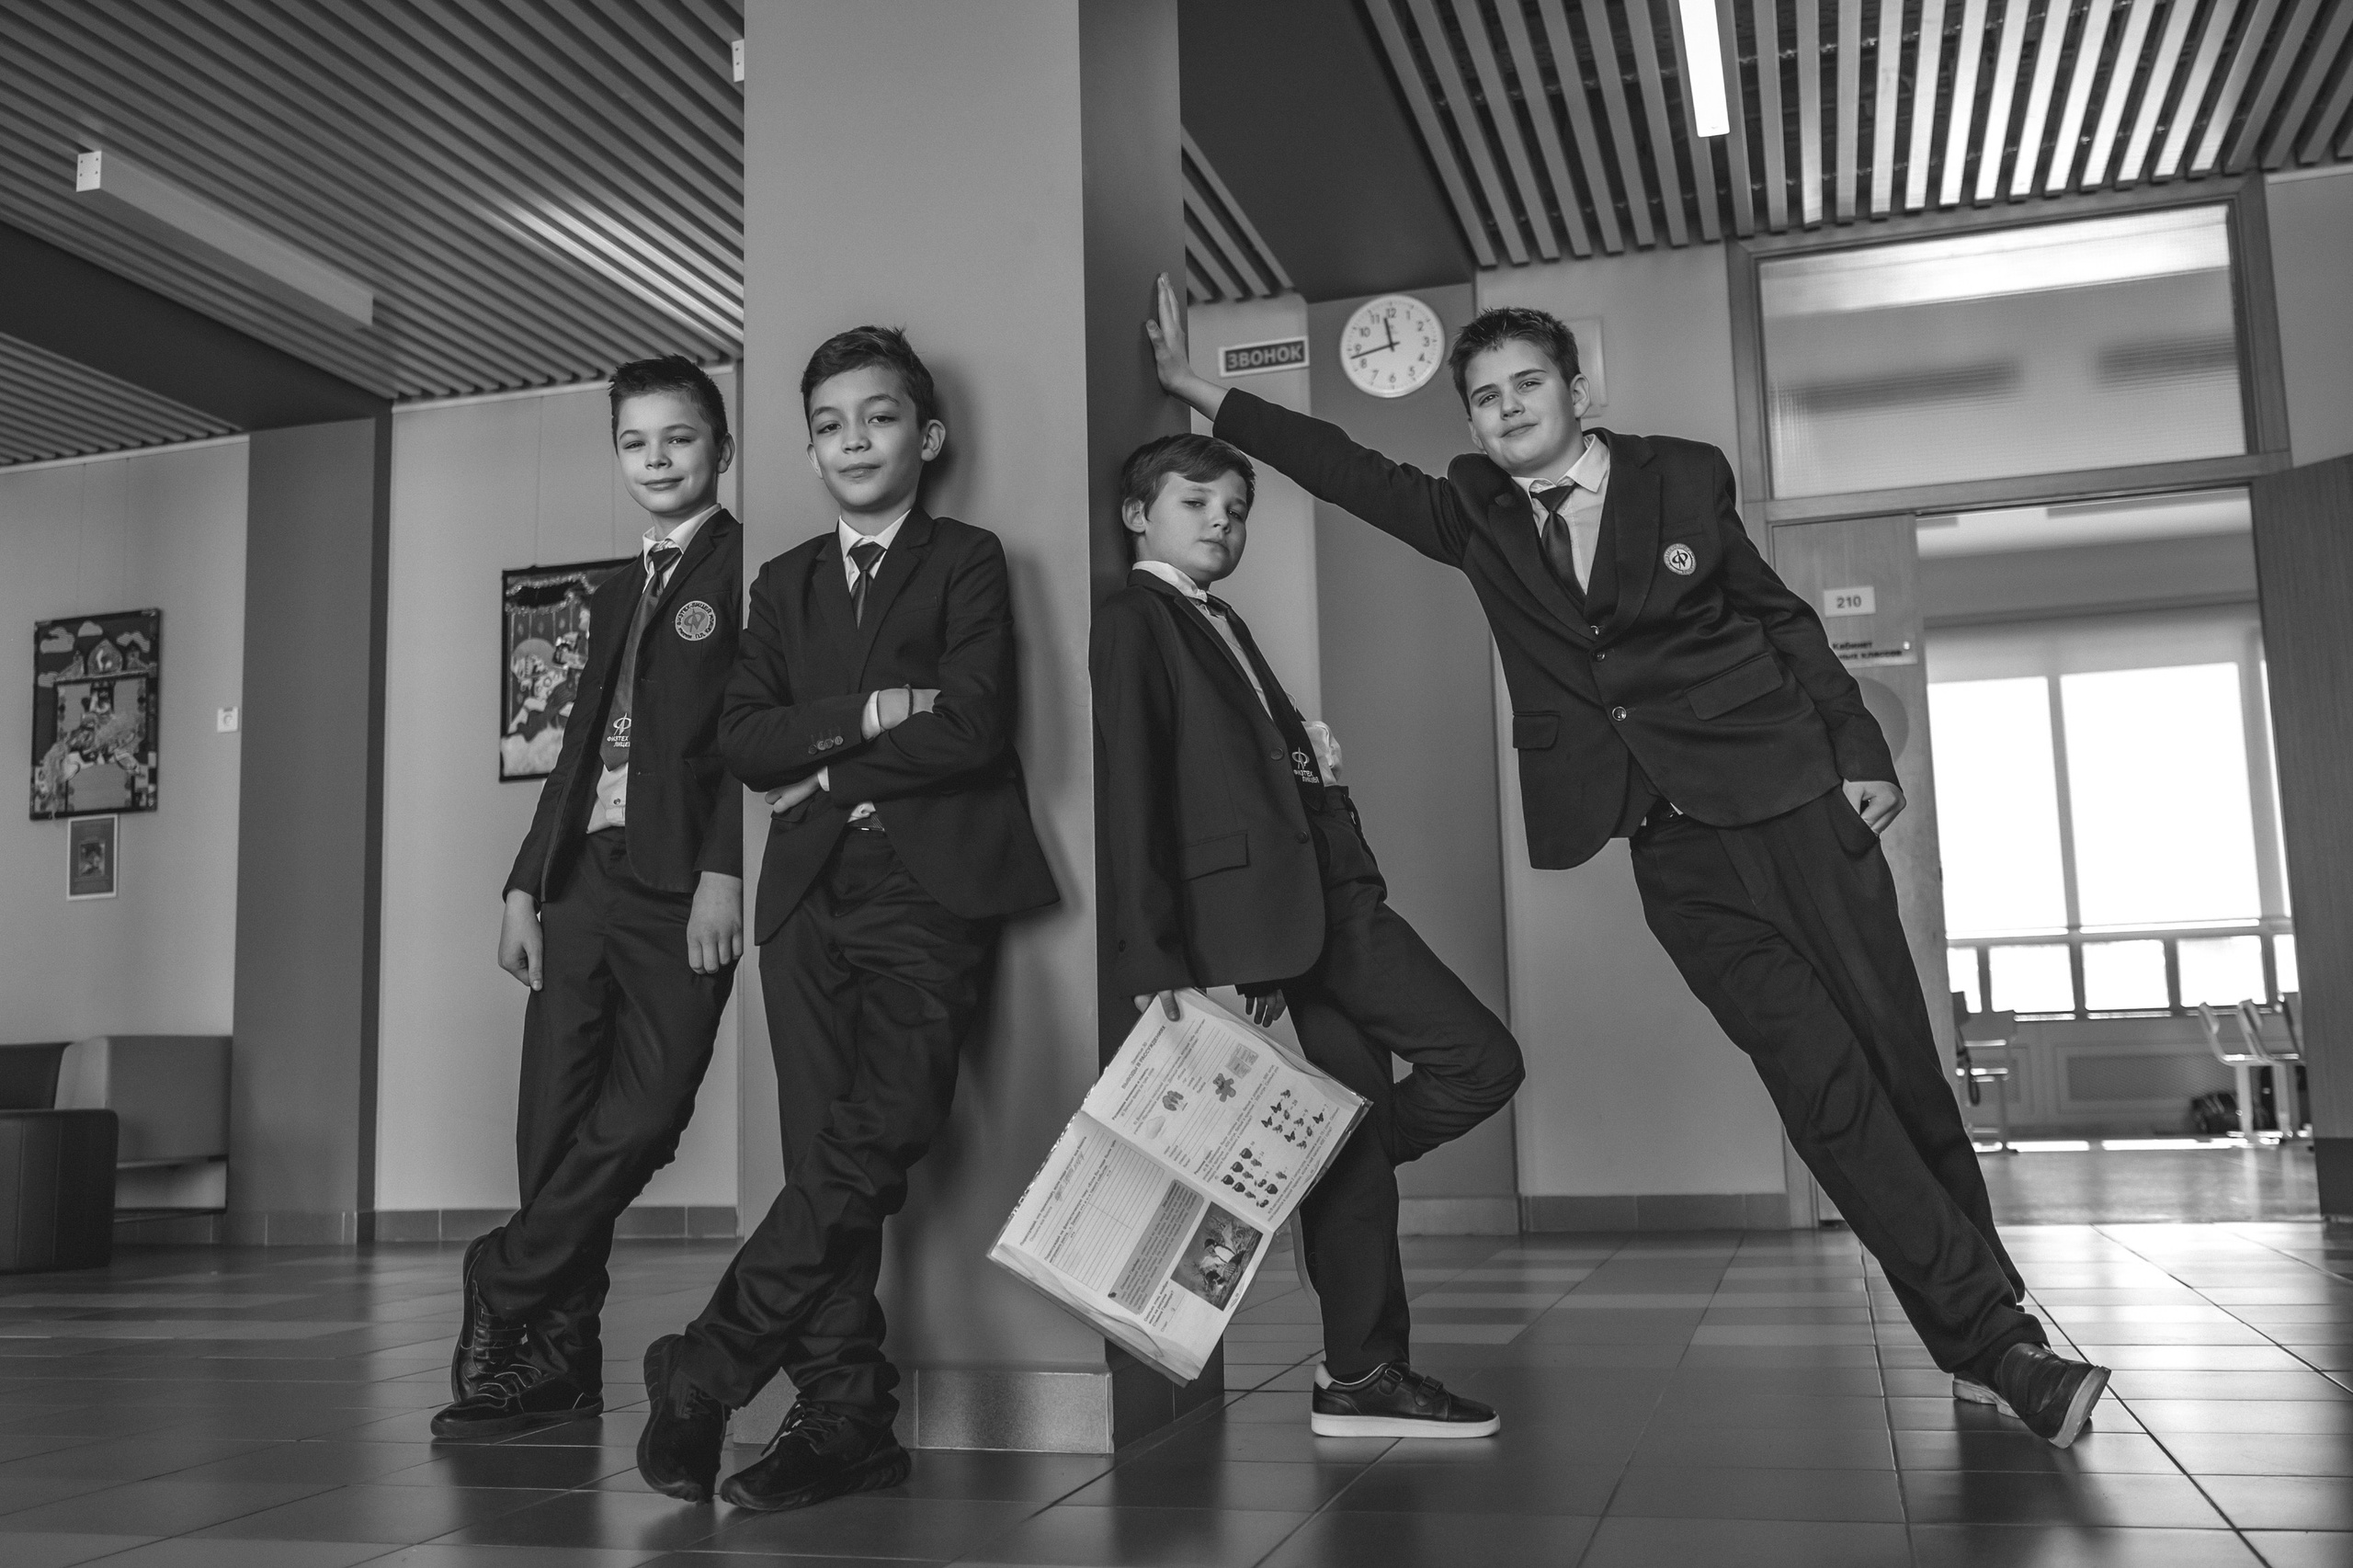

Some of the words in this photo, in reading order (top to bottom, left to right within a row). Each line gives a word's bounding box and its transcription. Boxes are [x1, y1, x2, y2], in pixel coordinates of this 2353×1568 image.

[1386, 308, 1396, 318] 12
[1406, 311, 1411, 320] 1
[1370, 314, 1380, 324] 11
[1417, 321, 1424, 331] 2
[1360, 327, 1370, 337] 10
[1423, 336, 1430, 347] 3
[1226, 344, 1303, 369] ЗВОНОК
[1418, 353, 1425, 361] 4
[1360, 358, 1367, 369] 8
[1372, 369, 1379, 380] 7
[1408, 366, 1415, 377] 5
[1389, 372, 1396, 383] 6
[1836, 596, 1862, 608] 210
[1120, 1065, 1138, 1089] ВЫВОДЫ
[1139, 1025, 1165, 1062] РАССУЖДЕНИЯХ
